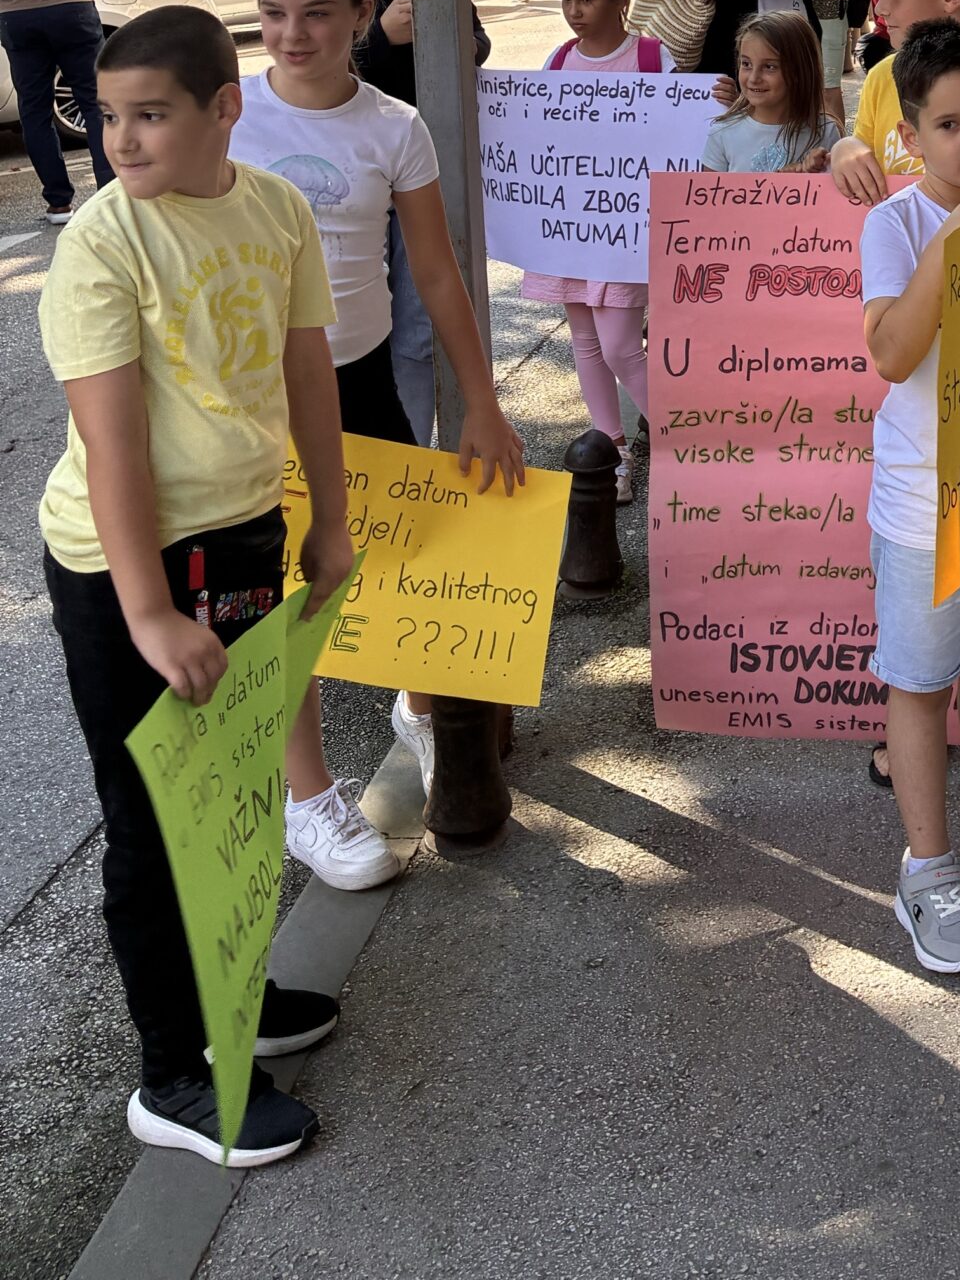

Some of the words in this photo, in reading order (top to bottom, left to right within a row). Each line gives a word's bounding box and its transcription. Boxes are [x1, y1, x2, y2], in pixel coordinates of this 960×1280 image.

[476, 73, 553, 102] inistrice,
[559, 77, 657, 107] pogledajte
[665, 79, 711, 107] djecu
[488, 101, 507, 118] oči
[524, 103, 529, 119] i
[543, 103, 600, 123] recite
[531, 144, 650, 181] UČITELJICA
[582, 189, 640, 214] ZBOG
[685, 175, 822, 207] Istraživali
[661, 219, 751, 255] Termin
[673, 263, 730, 304] NE
[745, 263, 864, 302] POSTOJ
[663, 337, 691, 377] U
[718, 344, 868, 382] diplomama
[834, 394, 874, 423] stu
[674, 439, 755, 464] visoke
[779, 432, 875, 464] stručne
[388, 464, 468, 508] datum
[741, 492, 855, 532] stekao/la
[664, 559, 669, 579] i
[799, 557, 878, 591] izdavanj
[379, 571, 386, 591] i
[396, 561, 539, 624] kvalitetnog
[659, 611, 746, 643] Podaci
[769, 615, 789, 636] iz
[729, 641, 877, 674] ISTOVJET
[659, 685, 780, 706] unesenim
[793, 675, 890, 707] DOKUM
[727, 711, 793, 729] EMIS
[216, 850, 282, 982] NAJBOL
